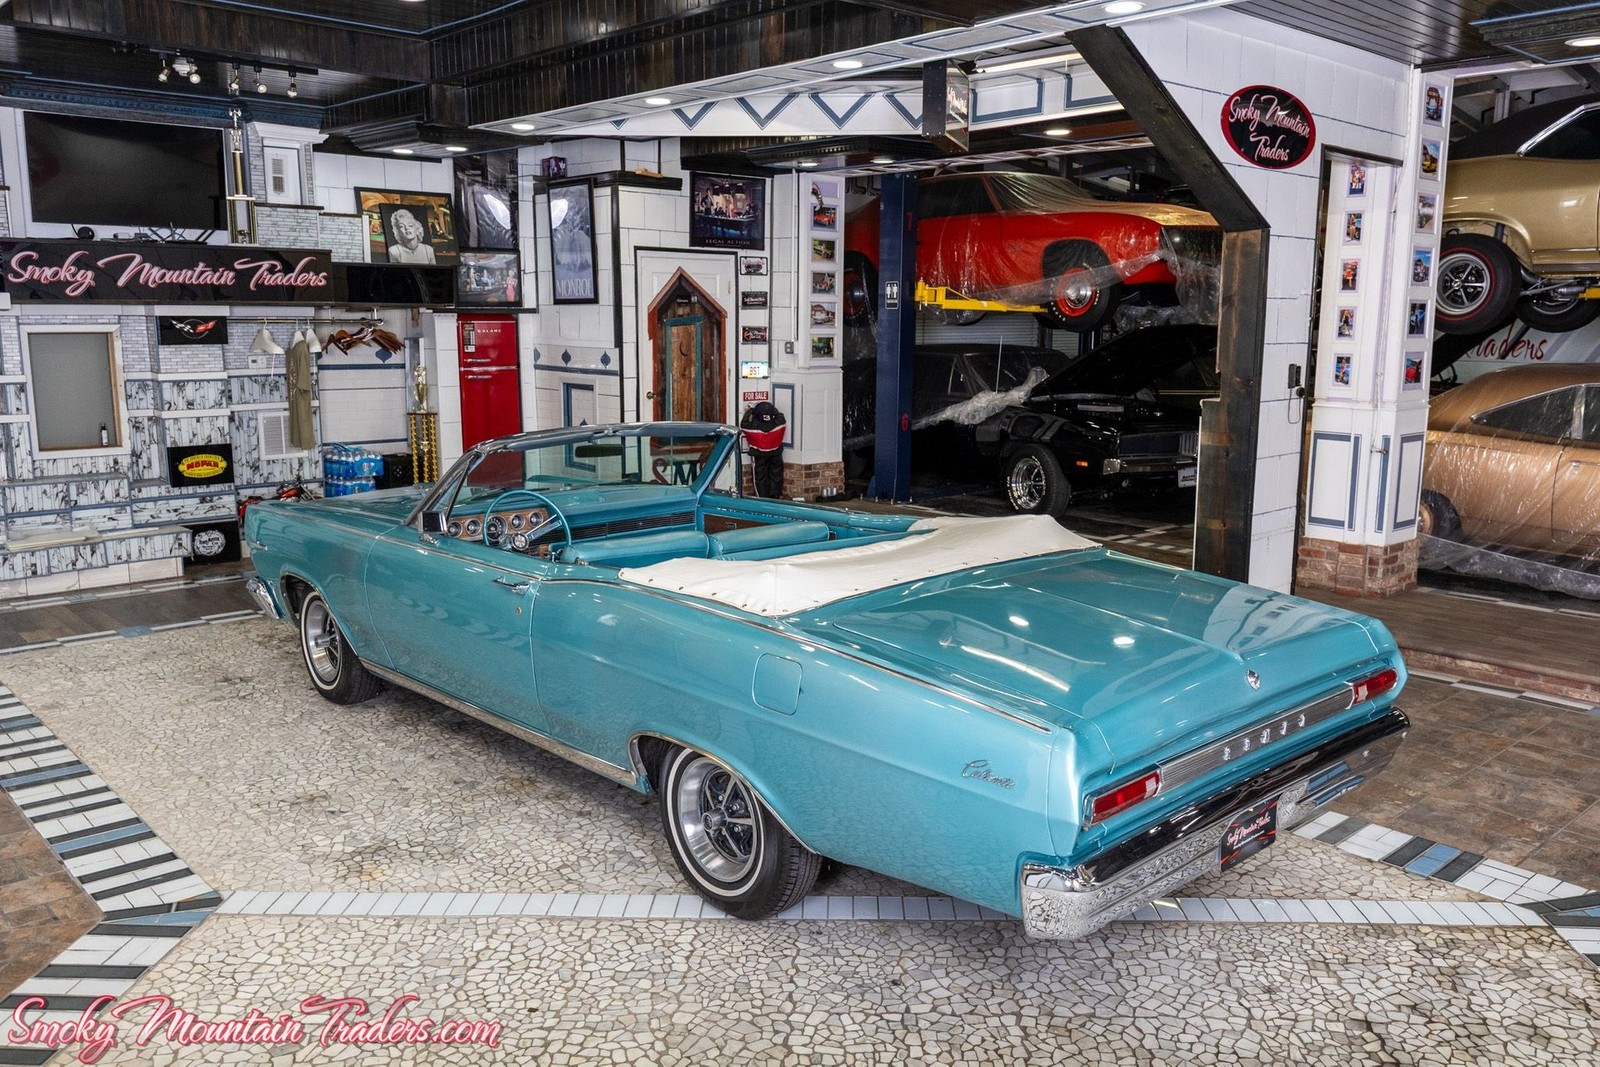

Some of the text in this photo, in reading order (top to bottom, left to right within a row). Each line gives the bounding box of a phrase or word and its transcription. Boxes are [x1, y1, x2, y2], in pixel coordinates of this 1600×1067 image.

[1229, 93, 1310, 138] Smoky Mountain
[1249, 132, 1290, 161] Traders
[8, 250, 328, 297] Smoky Mountain Traders
[755, 392, 767, 400] SALE
[186, 460, 219, 470] MOPAR
